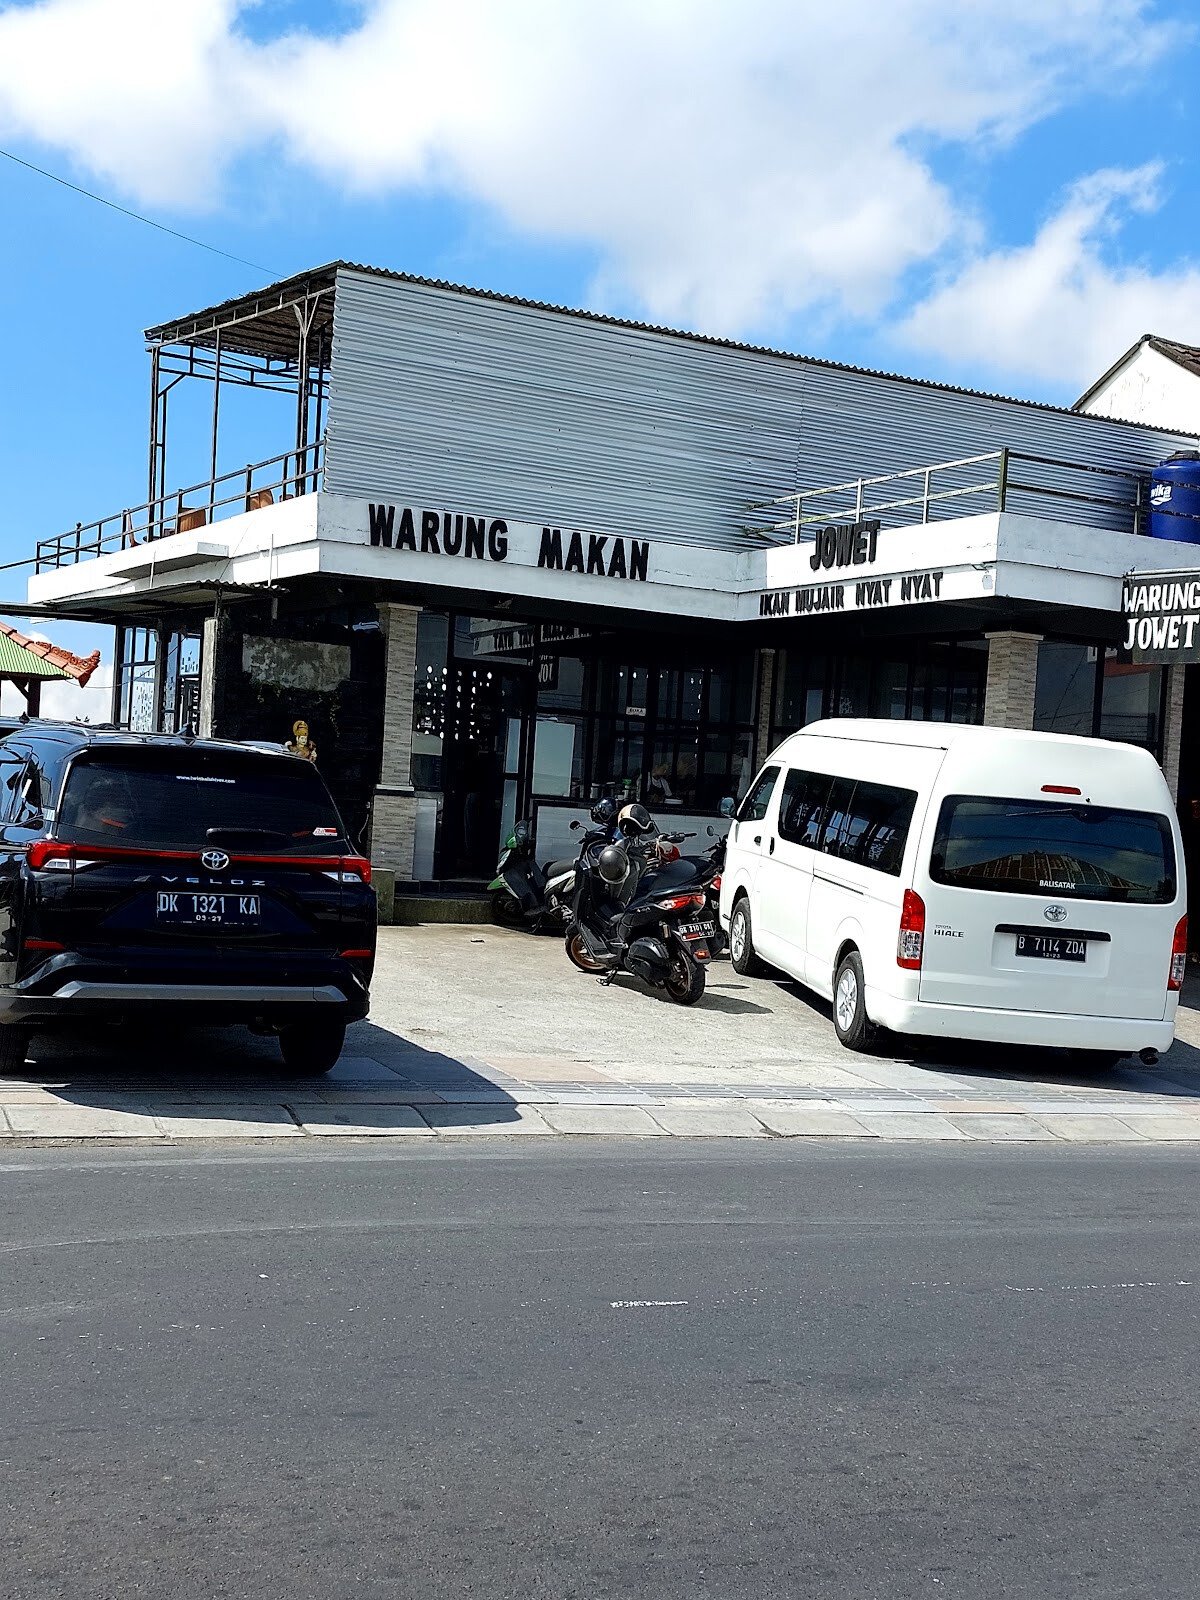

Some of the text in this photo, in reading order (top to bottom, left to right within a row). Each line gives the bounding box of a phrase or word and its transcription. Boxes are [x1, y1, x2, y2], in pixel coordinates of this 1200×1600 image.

[368, 503, 649, 582] WARUNG MAKAN
[810, 520, 880, 571] JOWET
[759, 571, 943, 616] IKAN MUJAIR NYAT NYAT
[1124, 582, 1200, 613] WARUNG
[1123, 614, 1199, 650] JOWET
[161, 875, 265, 886] VELOZ
[160, 894, 257, 915] DK 1321 KA
[934, 929, 964, 938] HIACE
[1018, 937, 1085, 955] B 7114 ZDA
